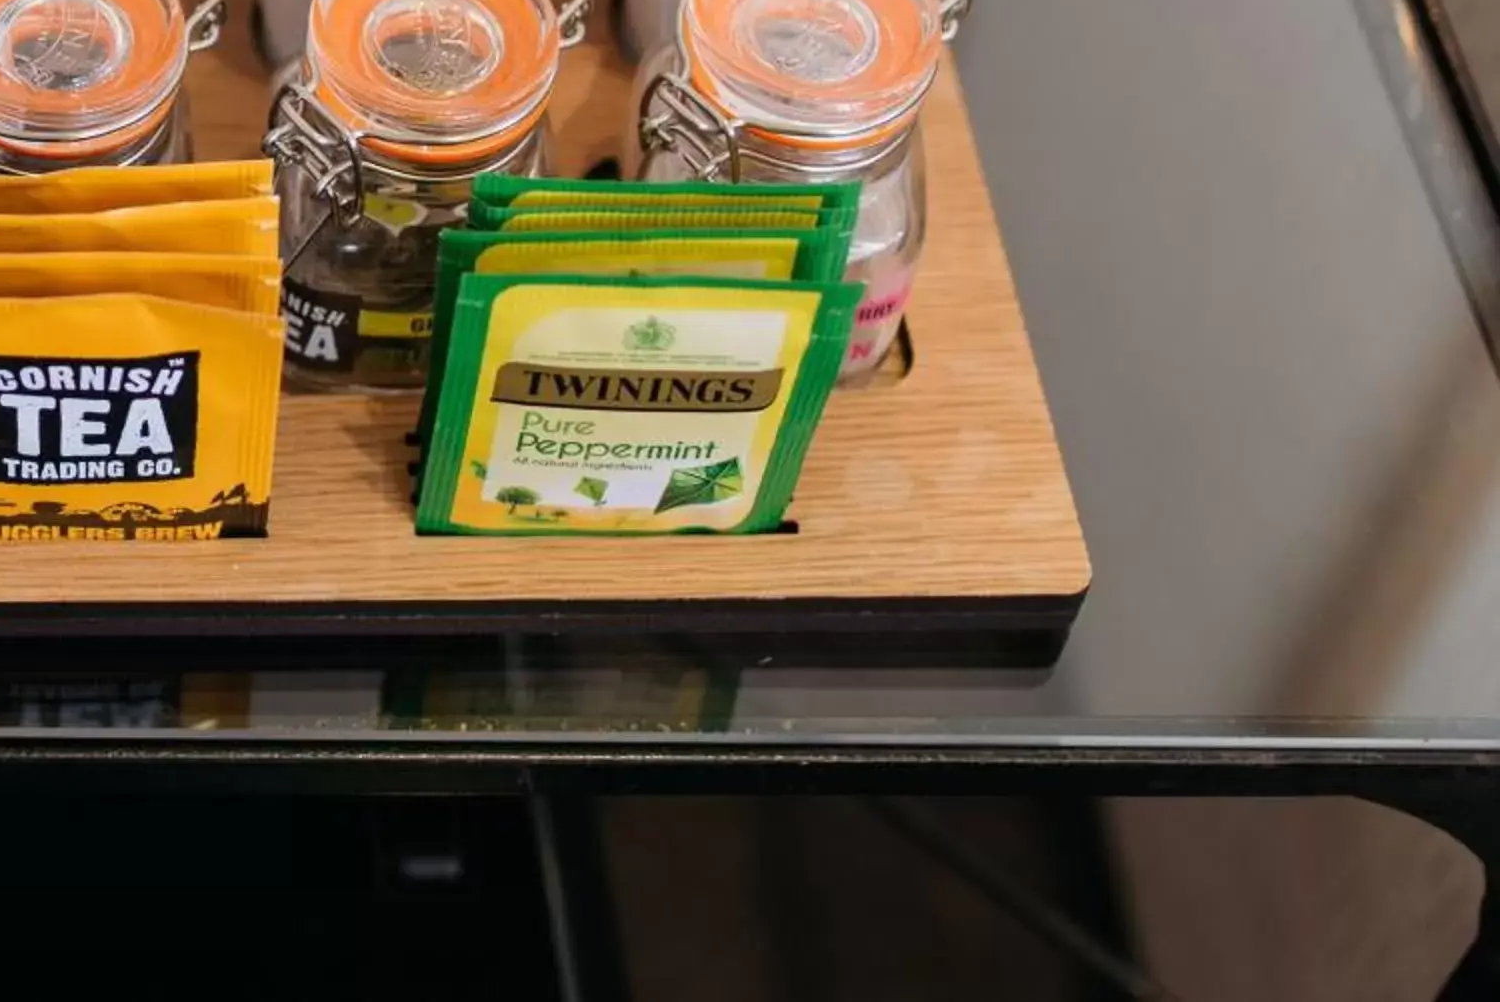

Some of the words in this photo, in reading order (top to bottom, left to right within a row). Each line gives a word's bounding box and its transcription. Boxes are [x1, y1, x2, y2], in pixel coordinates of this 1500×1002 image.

[287, 294, 346, 328] NISH
[285, 314, 339, 362] EA
[523, 370, 756, 404] TWININGS
[0, 394, 174, 457] TEA
[521, 411, 596, 435] Pure
[515, 432, 718, 461] Peppermint
[2, 458, 125, 480] TRADING
[137, 459, 181, 478] CO.
[135, 520, 224, 540] BREW
